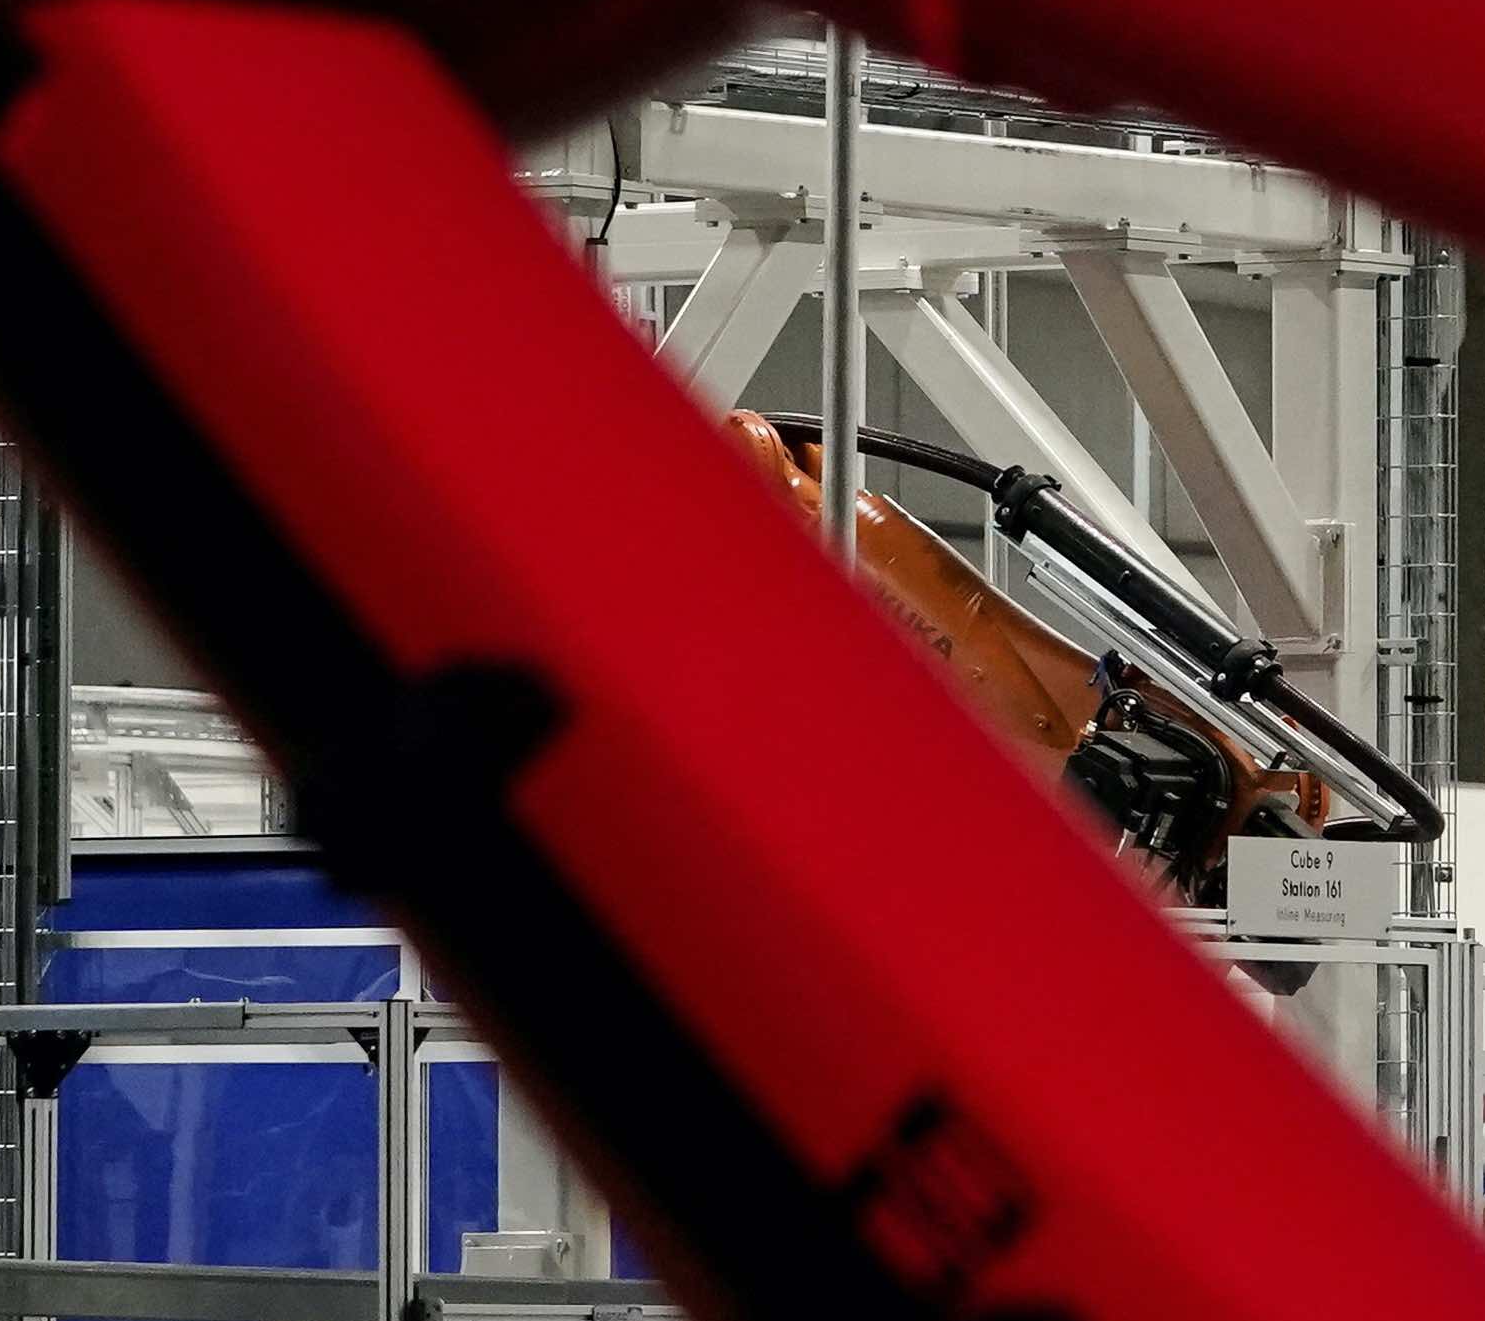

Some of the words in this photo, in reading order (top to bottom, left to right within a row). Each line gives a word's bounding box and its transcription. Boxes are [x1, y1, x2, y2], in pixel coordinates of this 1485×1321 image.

[1290, 849, 1321, 869] Cube
[1326, 851, 1334, 870] 9
[1282, 878, 1321, 898] Station
[1325, 879, 1342, 899] 161
[1303, 908, 1346, 927] Measuring
